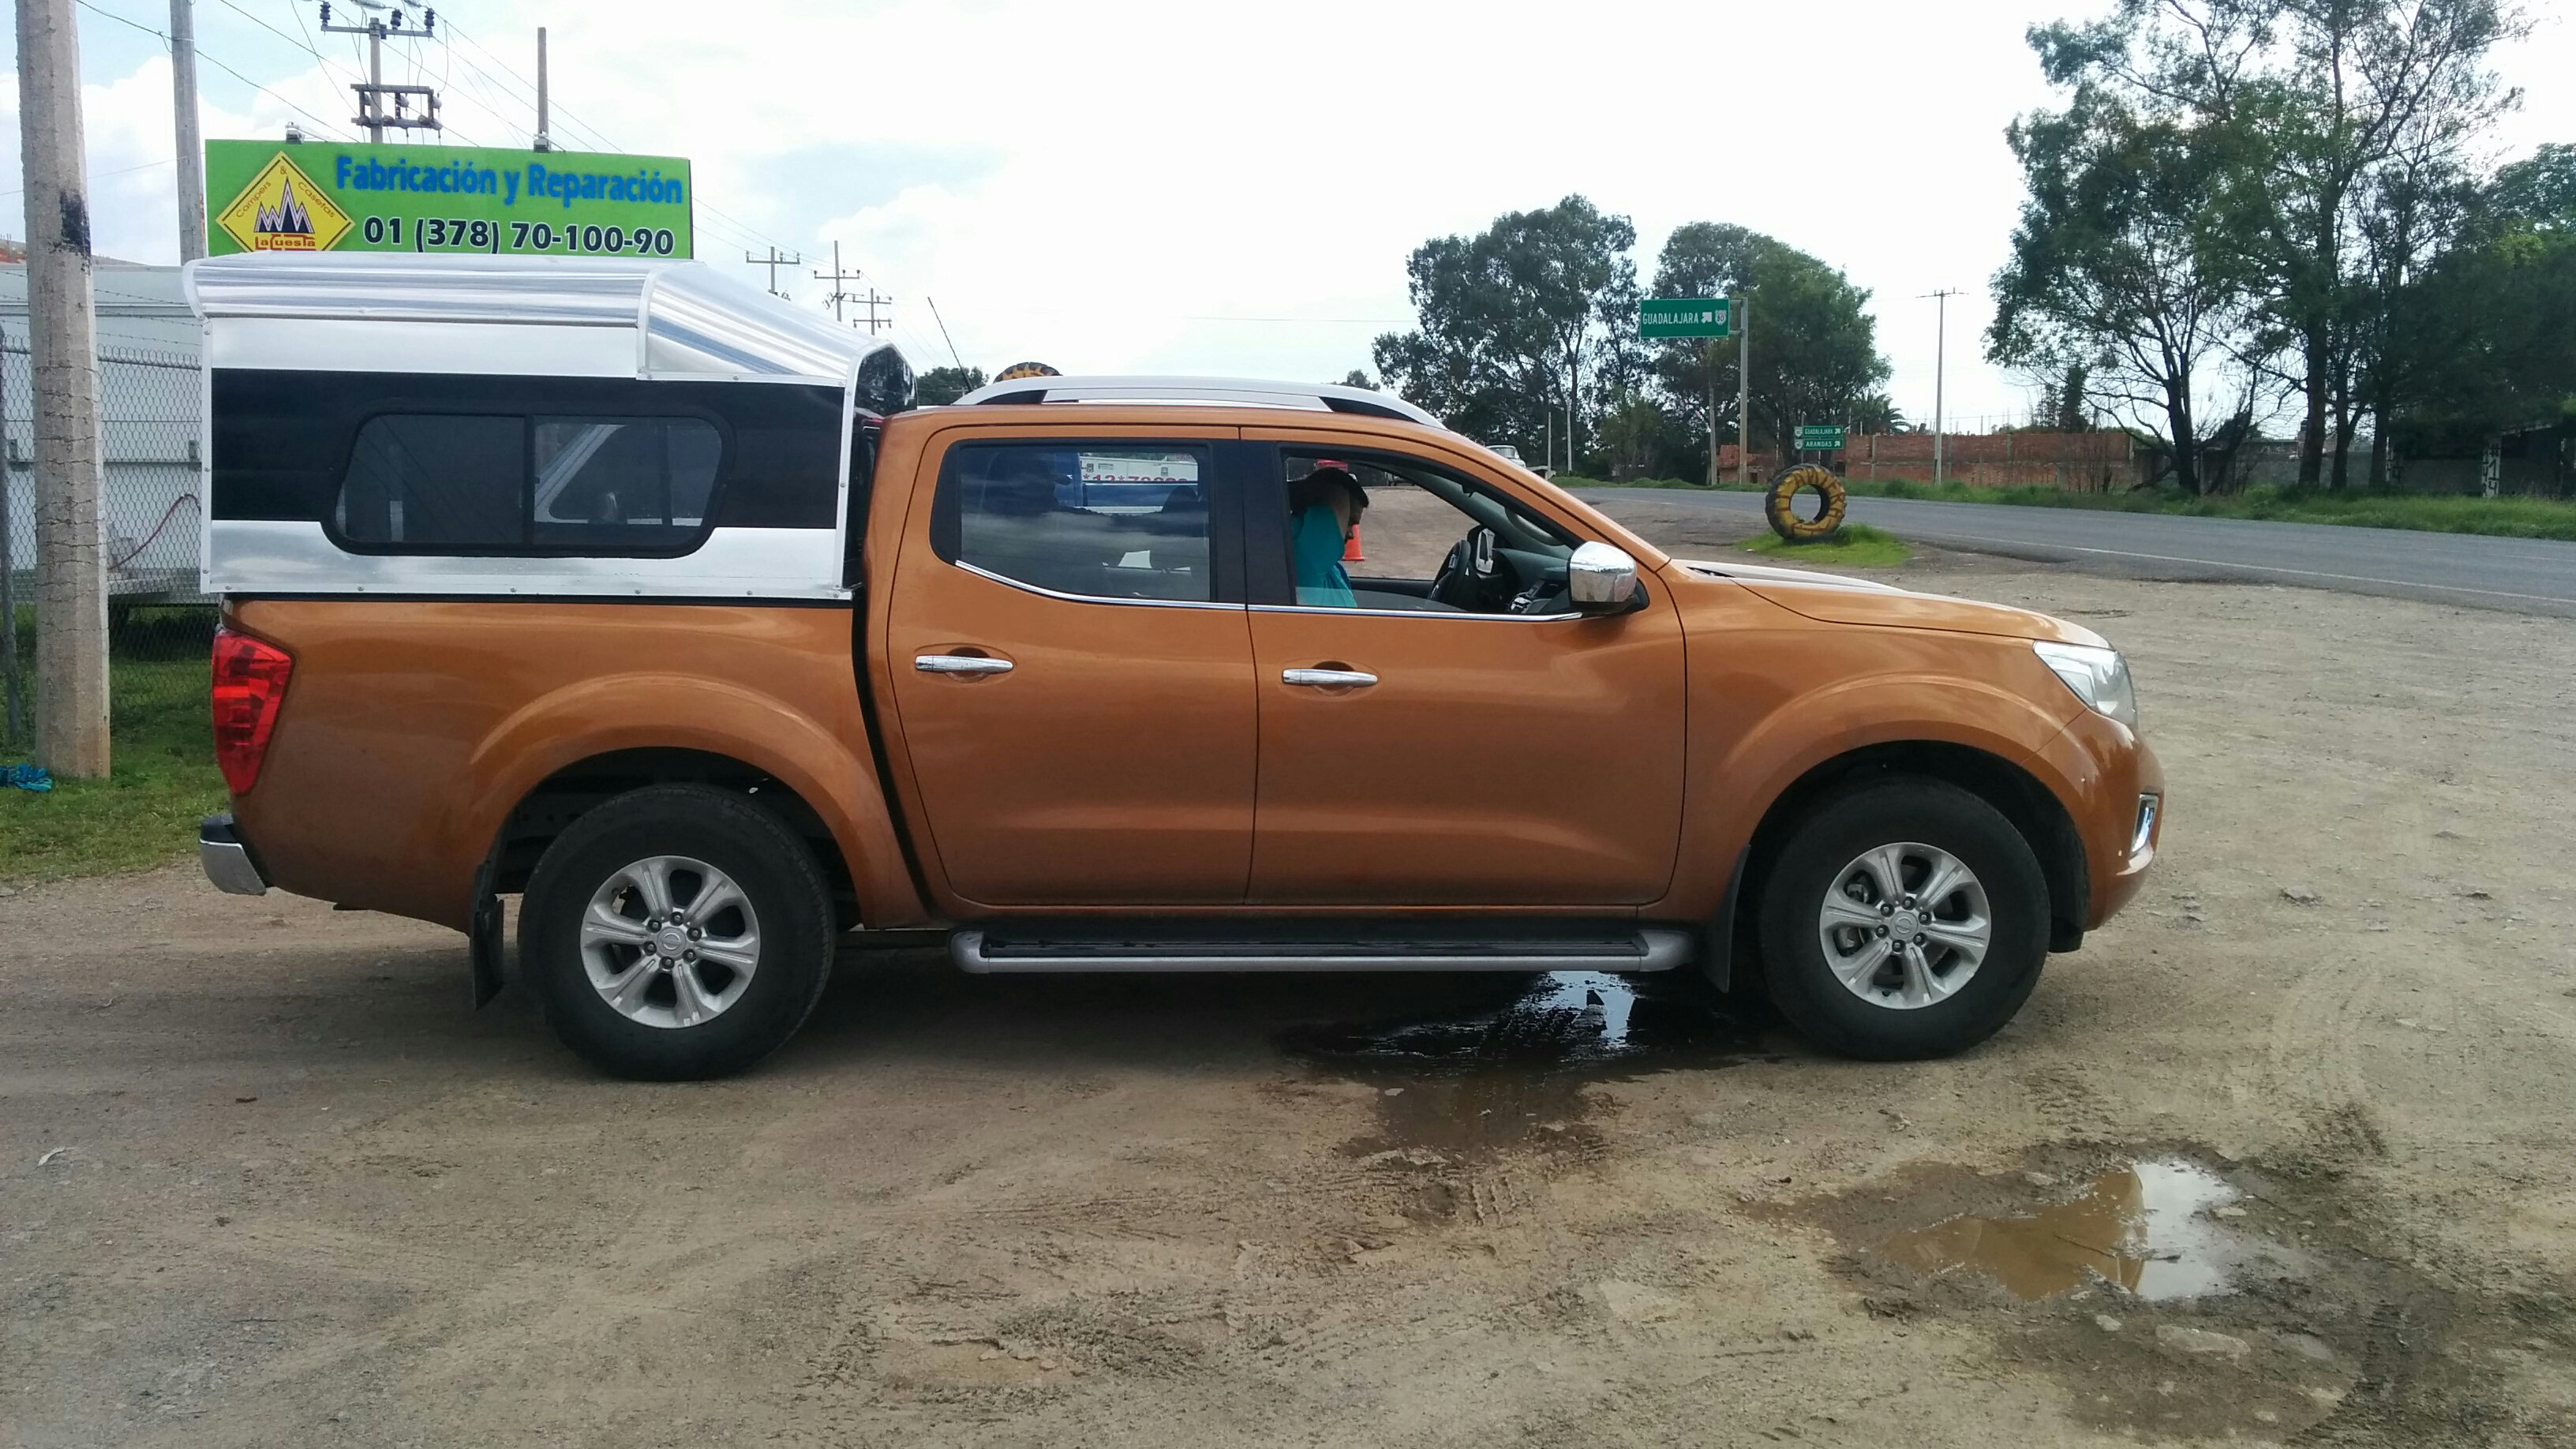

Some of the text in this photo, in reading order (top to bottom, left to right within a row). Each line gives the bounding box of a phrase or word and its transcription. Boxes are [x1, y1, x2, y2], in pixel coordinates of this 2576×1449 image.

[236, 181, 271, 218] Campers
[298, 181, 335, 218] Casetas
[335, 156, 683, 208] Fabricación y Reparación
[364, 215, 674, 255] 01 (378) 70-100-90
[1642, 312, 1699, 325] GUADALAJARA
